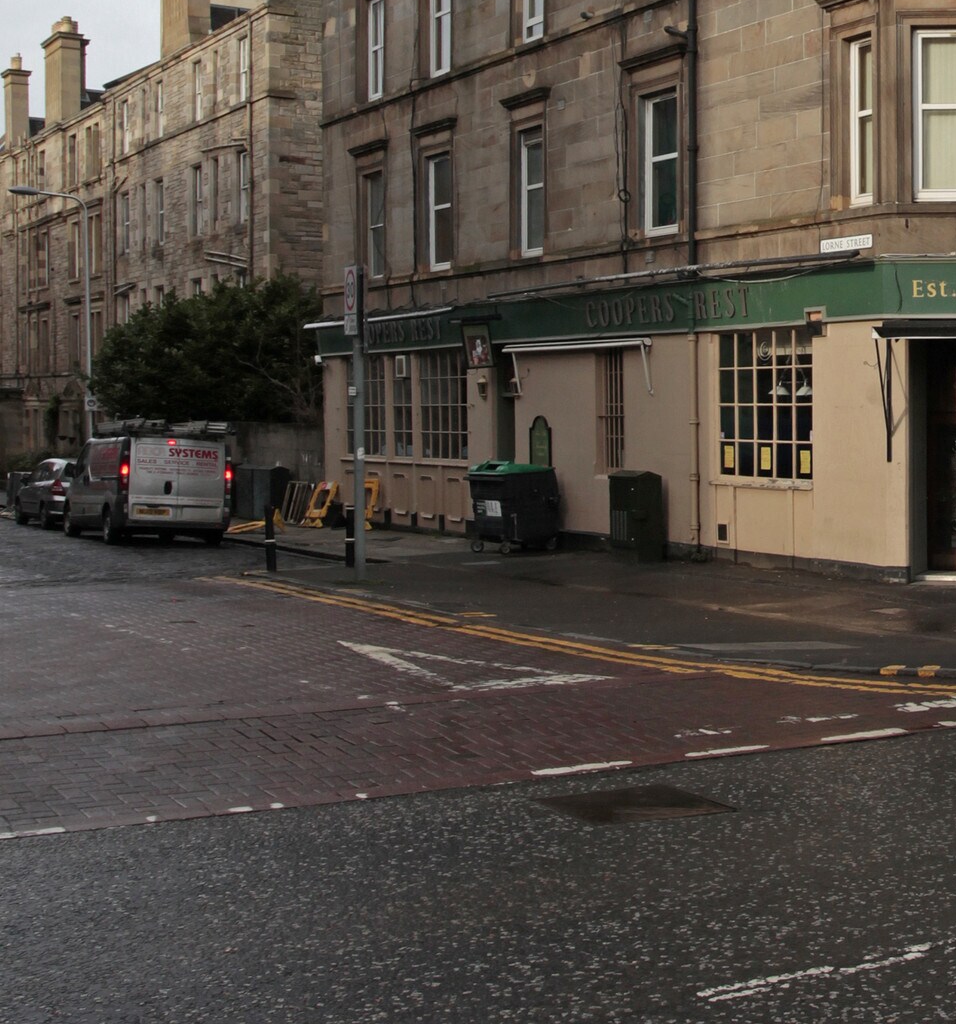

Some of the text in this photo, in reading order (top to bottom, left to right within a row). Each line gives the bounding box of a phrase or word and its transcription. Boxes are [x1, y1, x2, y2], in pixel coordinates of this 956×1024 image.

[821, 236, 872, 251] LORNE STREET
[911, 279, 956, 298] Est.
[585, 286, 749, 327] COOPERS REST
[368, 320, 405, 345] OPERS
[411, 316, 441, 341] REST
[168, 448, 219, 460] SYSTEMS
